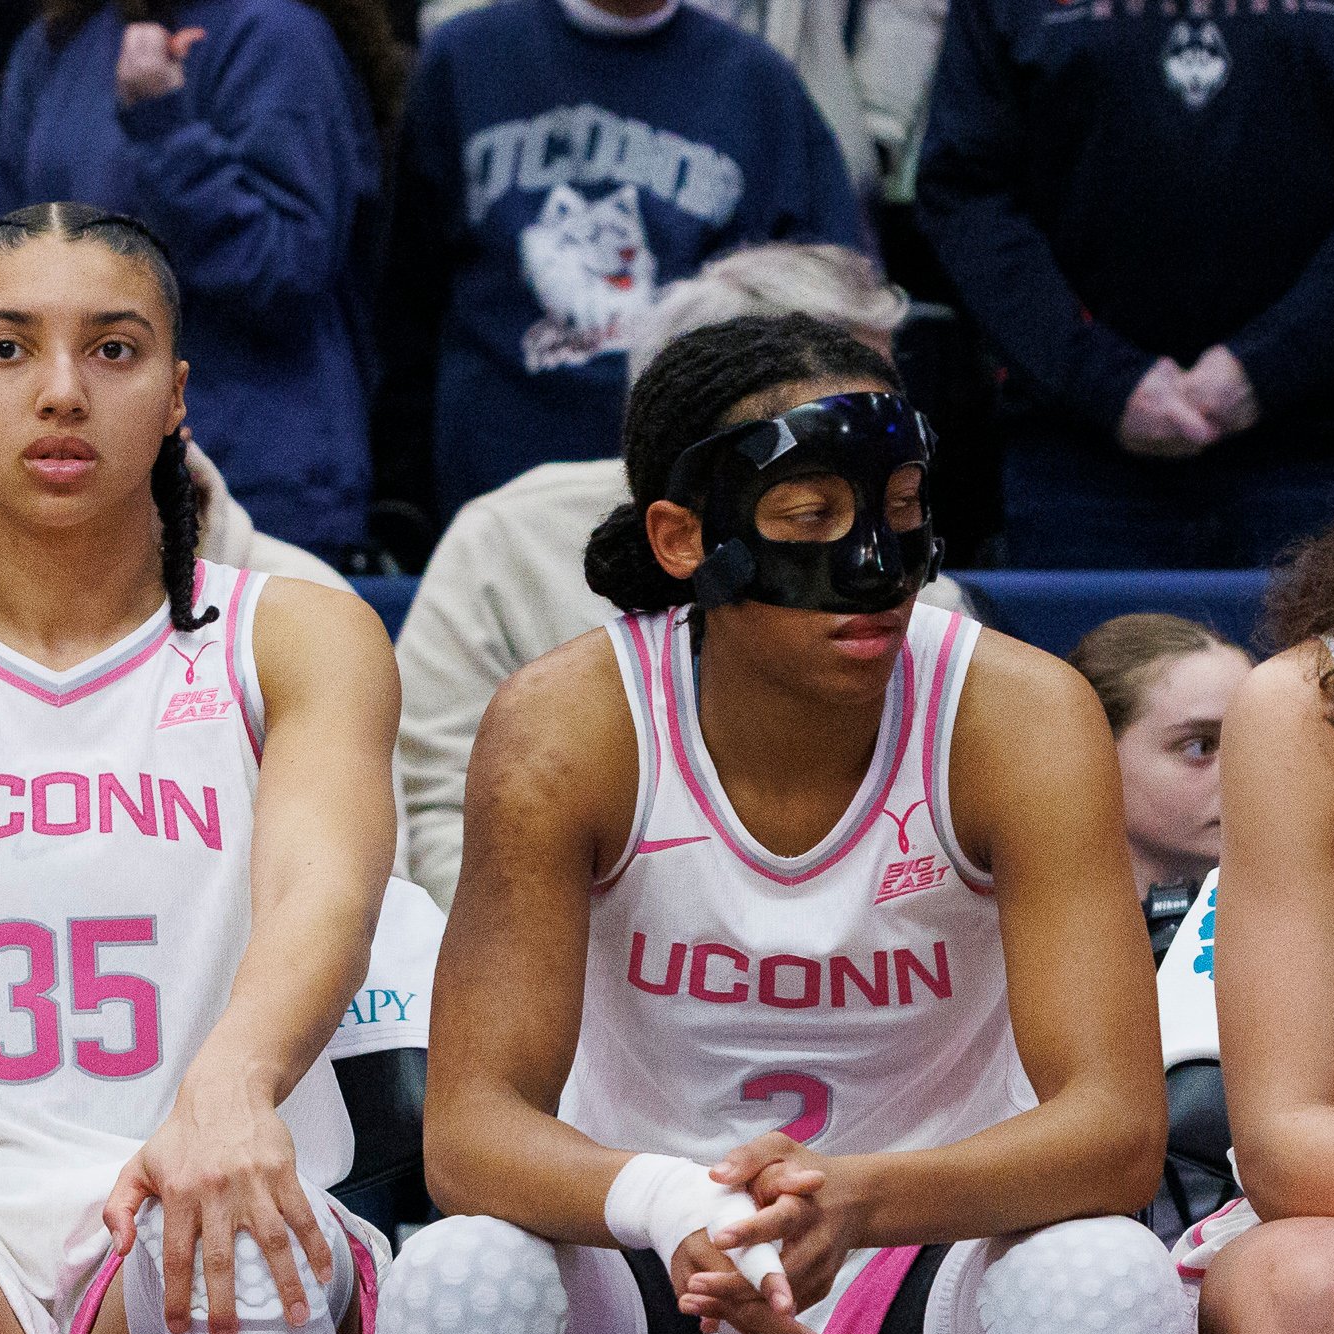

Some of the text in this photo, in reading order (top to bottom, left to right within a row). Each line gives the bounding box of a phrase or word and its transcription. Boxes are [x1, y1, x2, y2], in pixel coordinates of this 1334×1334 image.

[169, 687, 219, 707] BIG
[160, 701, 234, 722] EAST
[884, 855, 935, 880] BIG
[877, 865, 950, 895] EAST
[1152, 899, 1188, 911] Nikon
[627, 931, 953, 1009] UCONN
